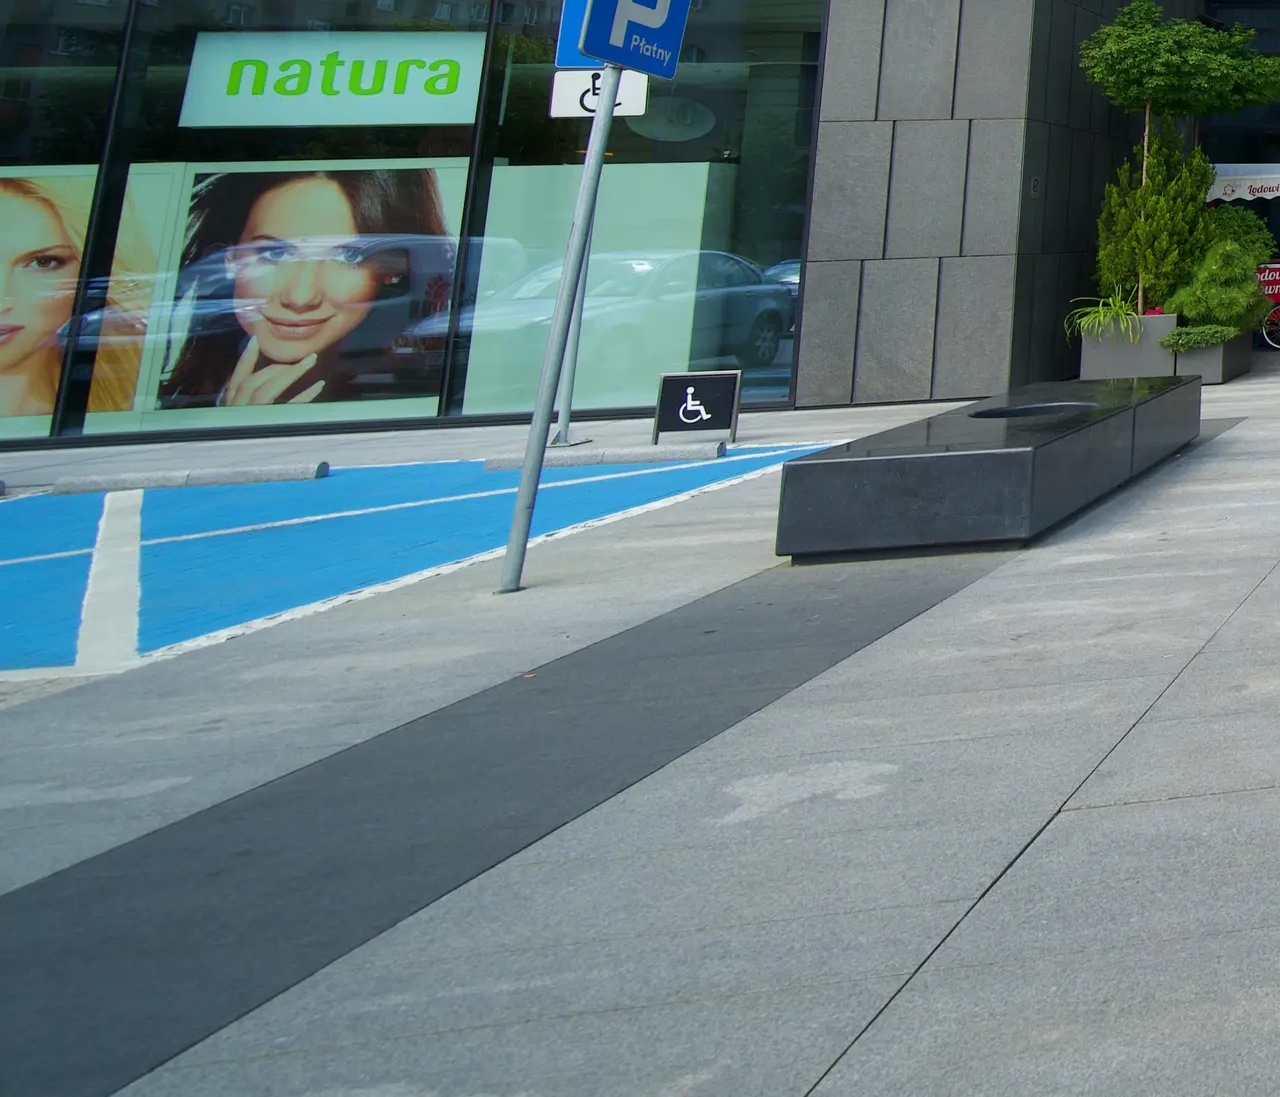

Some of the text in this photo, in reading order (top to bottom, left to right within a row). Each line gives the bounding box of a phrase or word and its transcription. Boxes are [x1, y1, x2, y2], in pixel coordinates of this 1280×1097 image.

[630, 34, 672, 67] Płatny
[225, 51, 462, 96] natura
[1247, 183, 1280, 196] Lodowi
